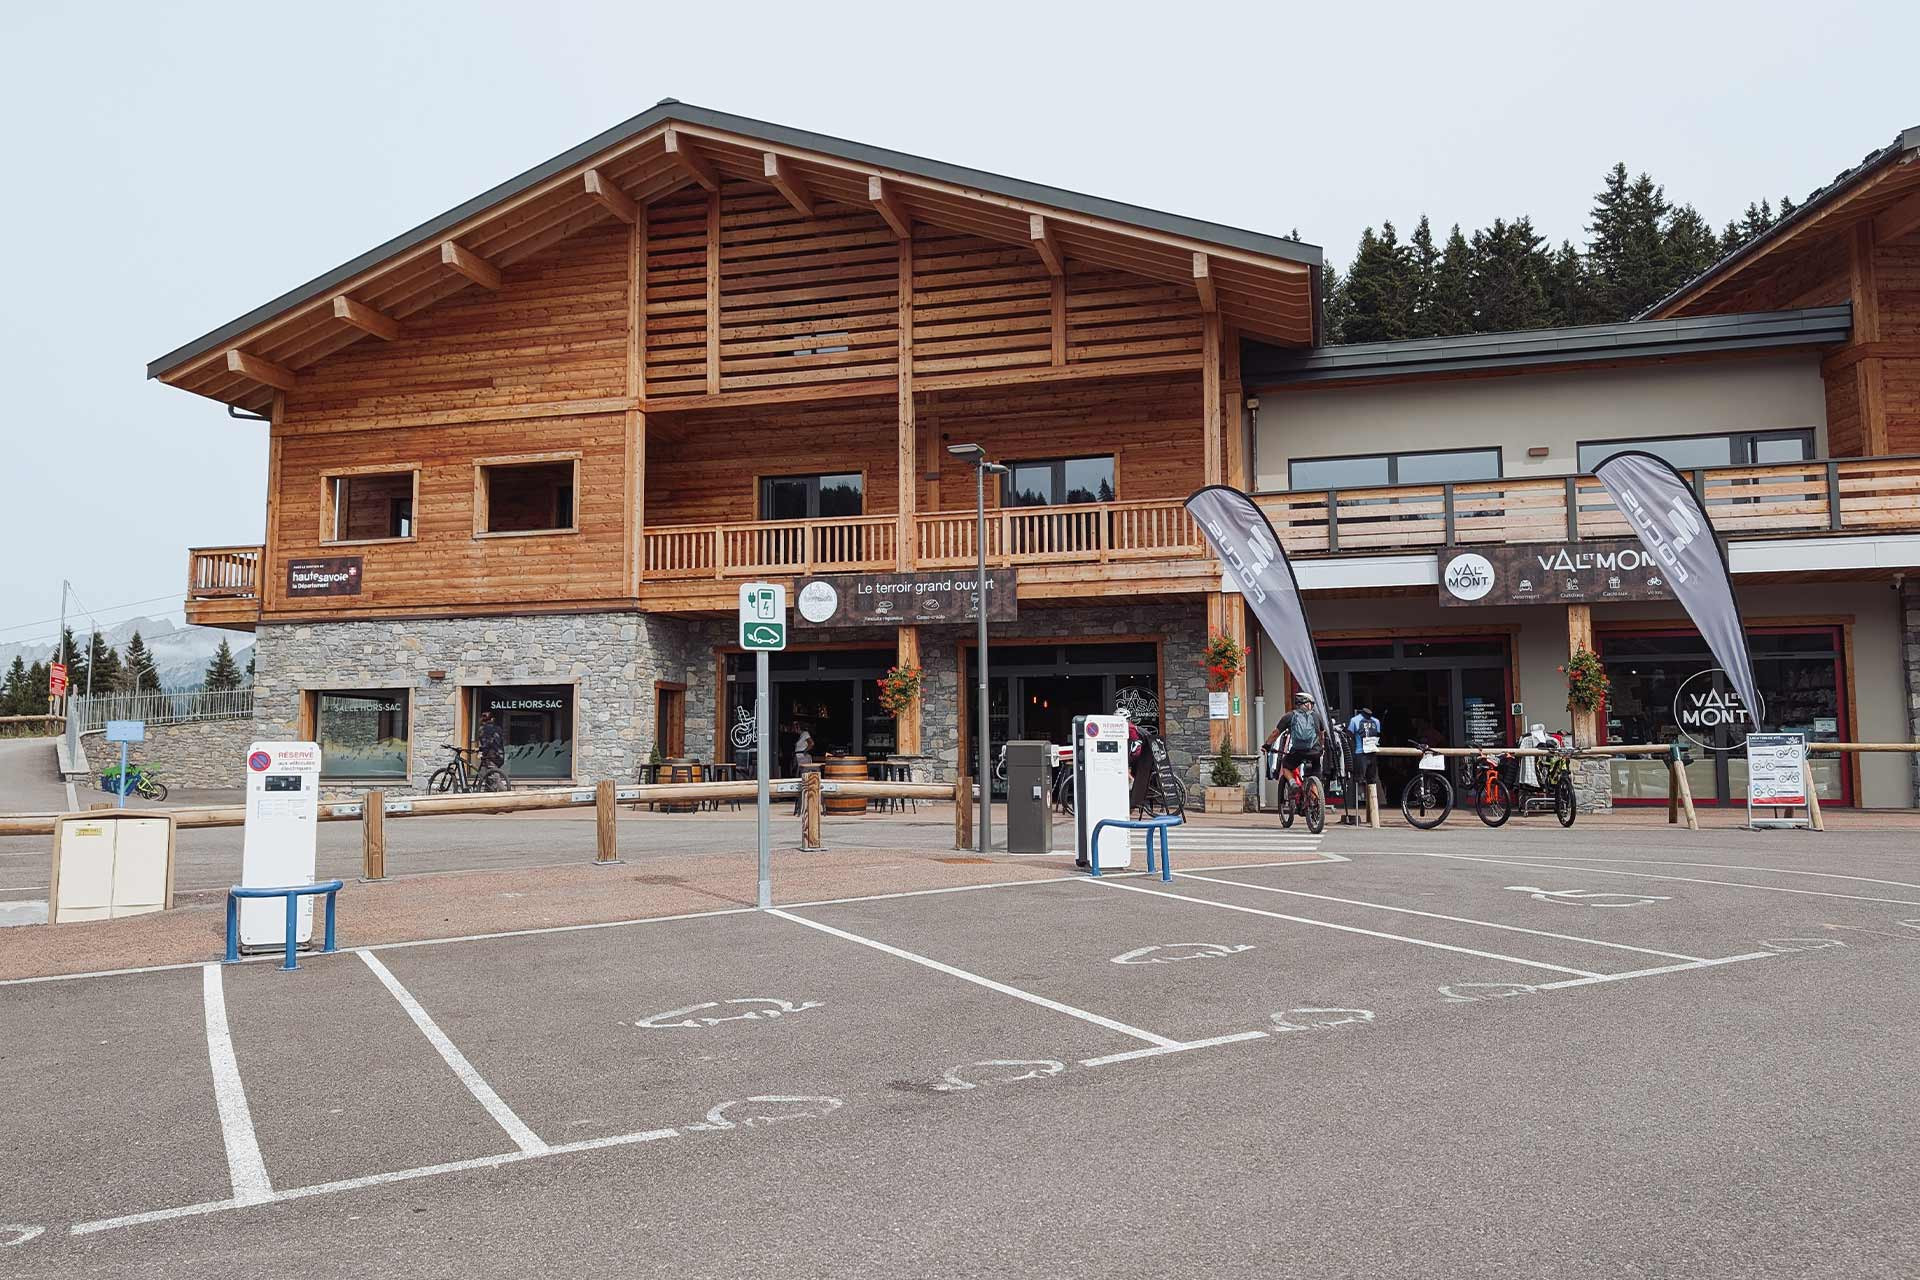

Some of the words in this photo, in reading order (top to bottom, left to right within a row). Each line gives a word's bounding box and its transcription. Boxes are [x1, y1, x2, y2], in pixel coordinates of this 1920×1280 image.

[1537, 548, 1591, 573] VAL
[1596, 549, 1656, 571] MON
[1453, 563, 1482, 577] VAL
[858, 583, 872, 594] Le
[876, 581, 912, 594] terroir
[915, 580, 951, 594] grand
[955, 578, 994, 591] ouvrt
[1448, 576, 1487, 588] MONT
[1123, 689, 1141, 701] LA
[1689, 687, 1739, 709] VAL
[334, 703, 359, 712] SALLE
[360, 703, 401, 712] HORS-SAC
[490, 701, 517, 710] SALLE
[518, 700, 563, 709] HORS-SAC
[1682, 708, 1748, 726] MONT
